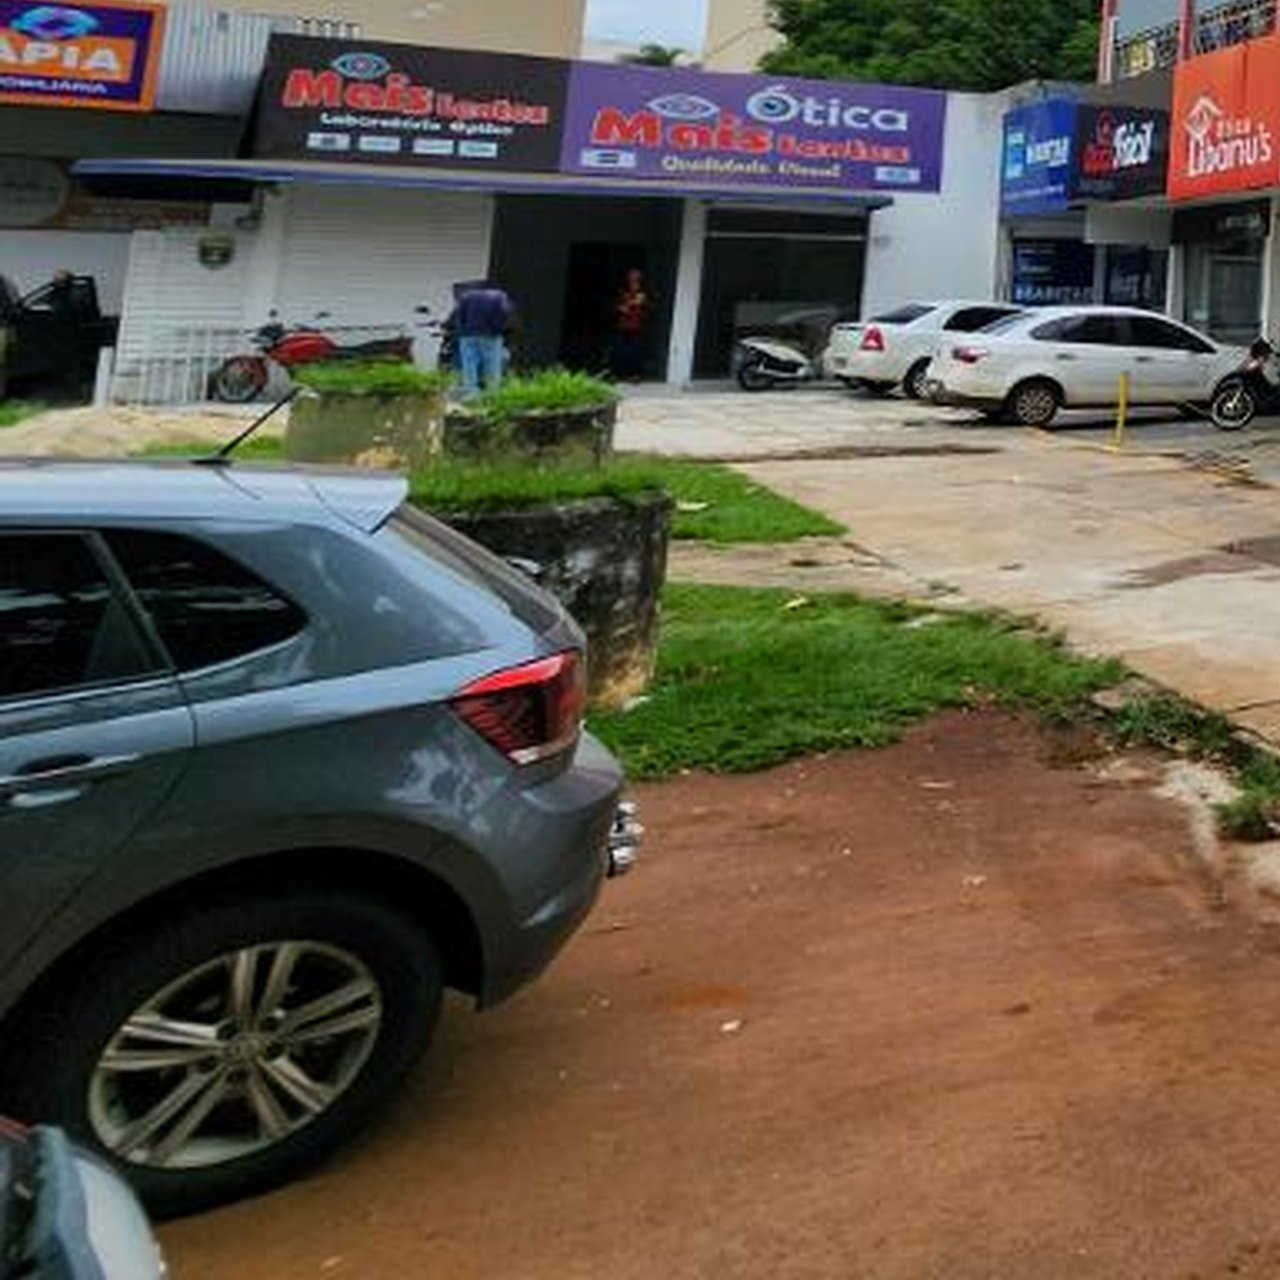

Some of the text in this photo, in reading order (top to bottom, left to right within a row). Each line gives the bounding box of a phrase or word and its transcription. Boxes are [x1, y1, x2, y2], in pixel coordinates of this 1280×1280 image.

[283, 69, 433, 115] Mais
[745, 85, 908, 131] Ótica
[590, 106, 774, 155] Mais
